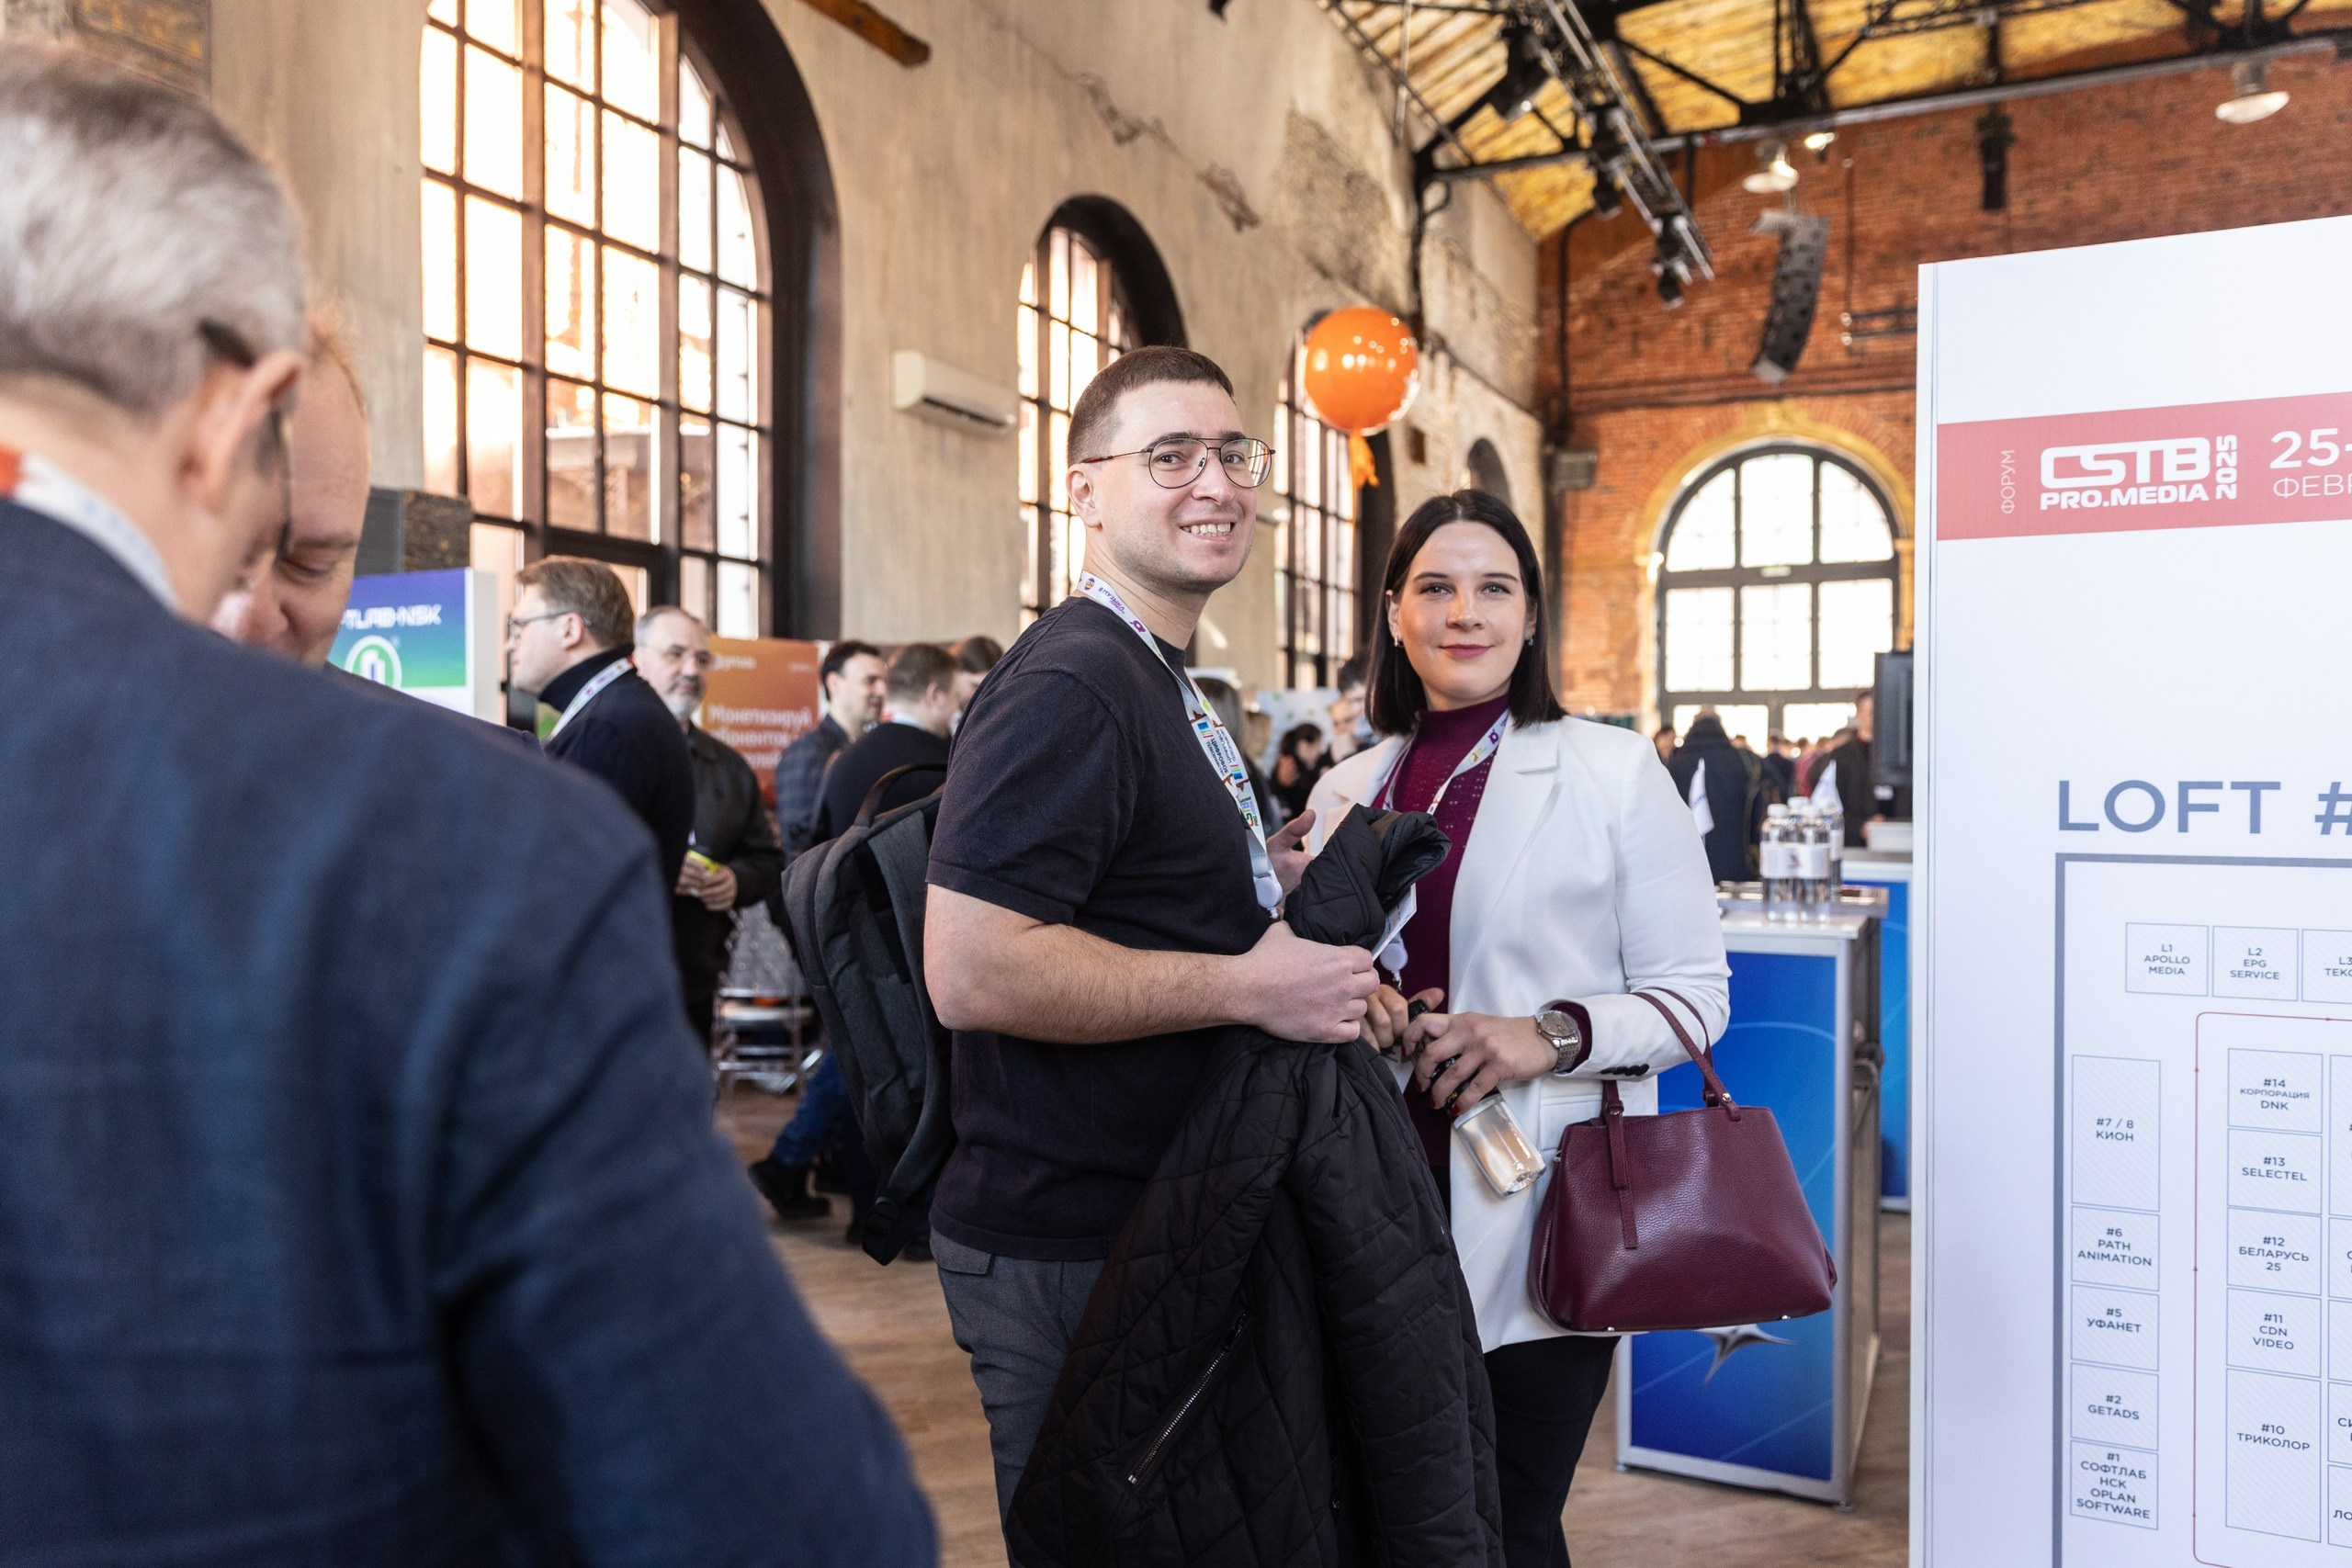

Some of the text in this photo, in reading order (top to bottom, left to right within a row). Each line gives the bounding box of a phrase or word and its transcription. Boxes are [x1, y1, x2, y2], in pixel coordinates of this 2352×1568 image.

[2040, 436, 2211, 490] CSTB
[2215, 434, 2237, 500] 2025
[2000, 449, 2016, 514] ФОРУМ
[2040, 482, 2209, 511] PRO.MEDIA
[1210, 738, 1229, 773] ЦИФРОВОЕ
[2058, 779, 2280, 834] LOFT
[2162, 944, 2173, 953] L1
[2248, 948, 2262, 956] L2
[2143, 955, 2190, 964] APOLLO
[2244, 959, 2267, 967] EPG
[2149, 966, 2185, 975] MEDIA
[2230, 970, 2279, 979] SERVICE
[2264, 1078, 2286, 1088] #14
[2240, 1089, 2310, 1100] КОРПОРАЦИЯ
[2261, 1100, 2289, 1111] DNK
[2097, 1119, 2112, 1127] #7
[2127, 1121, 2134, 1129] 8
[2096, 1131, 2134, 1142] КИОН
[2264, 1156, 2285, 1167] #13
[2242, 1168, 2307, 1180] SELECTEL
[2107, 1228, 2122, 1236] #6
[2098, 1240, 2131, 1250] PATH
[2263, 1237, 2285, 1247] #12
[2077, 1251, 2153, 1267] ANIMATION
[2239, 1247, 2309, 1262] БЕЛАРУСЬ
[2266, 1262, 2281, 1271] 25
[2107, 1308, 2121, 1317] #5
[2264, 1314, 2283, 1324] #11
[2087, 1318, 2141, 1333] УФАНЕТ
[2259, 1326, 2288, 1337] CDN
[2253, 1337, 2294, 1349] VIDEO
[2106, 1395, 2121, 1404] #2
[2088, 1405, 2140, 1420] GETADS
[2261, 1424, 2285, 1435] #10
[2237, 1433, 2310, 1451] ТРИКОЛОР
[2107, 1453, 2120, 1461] #1
[2081, 1461, 2146, 1479] СОФТЛАБ
[2100, 1477, 2127, 1489] НСК
[2090, 1489, 2136, 1503] OPLAN
[2076, 1499, 2150, 1518] SOFTWARE
